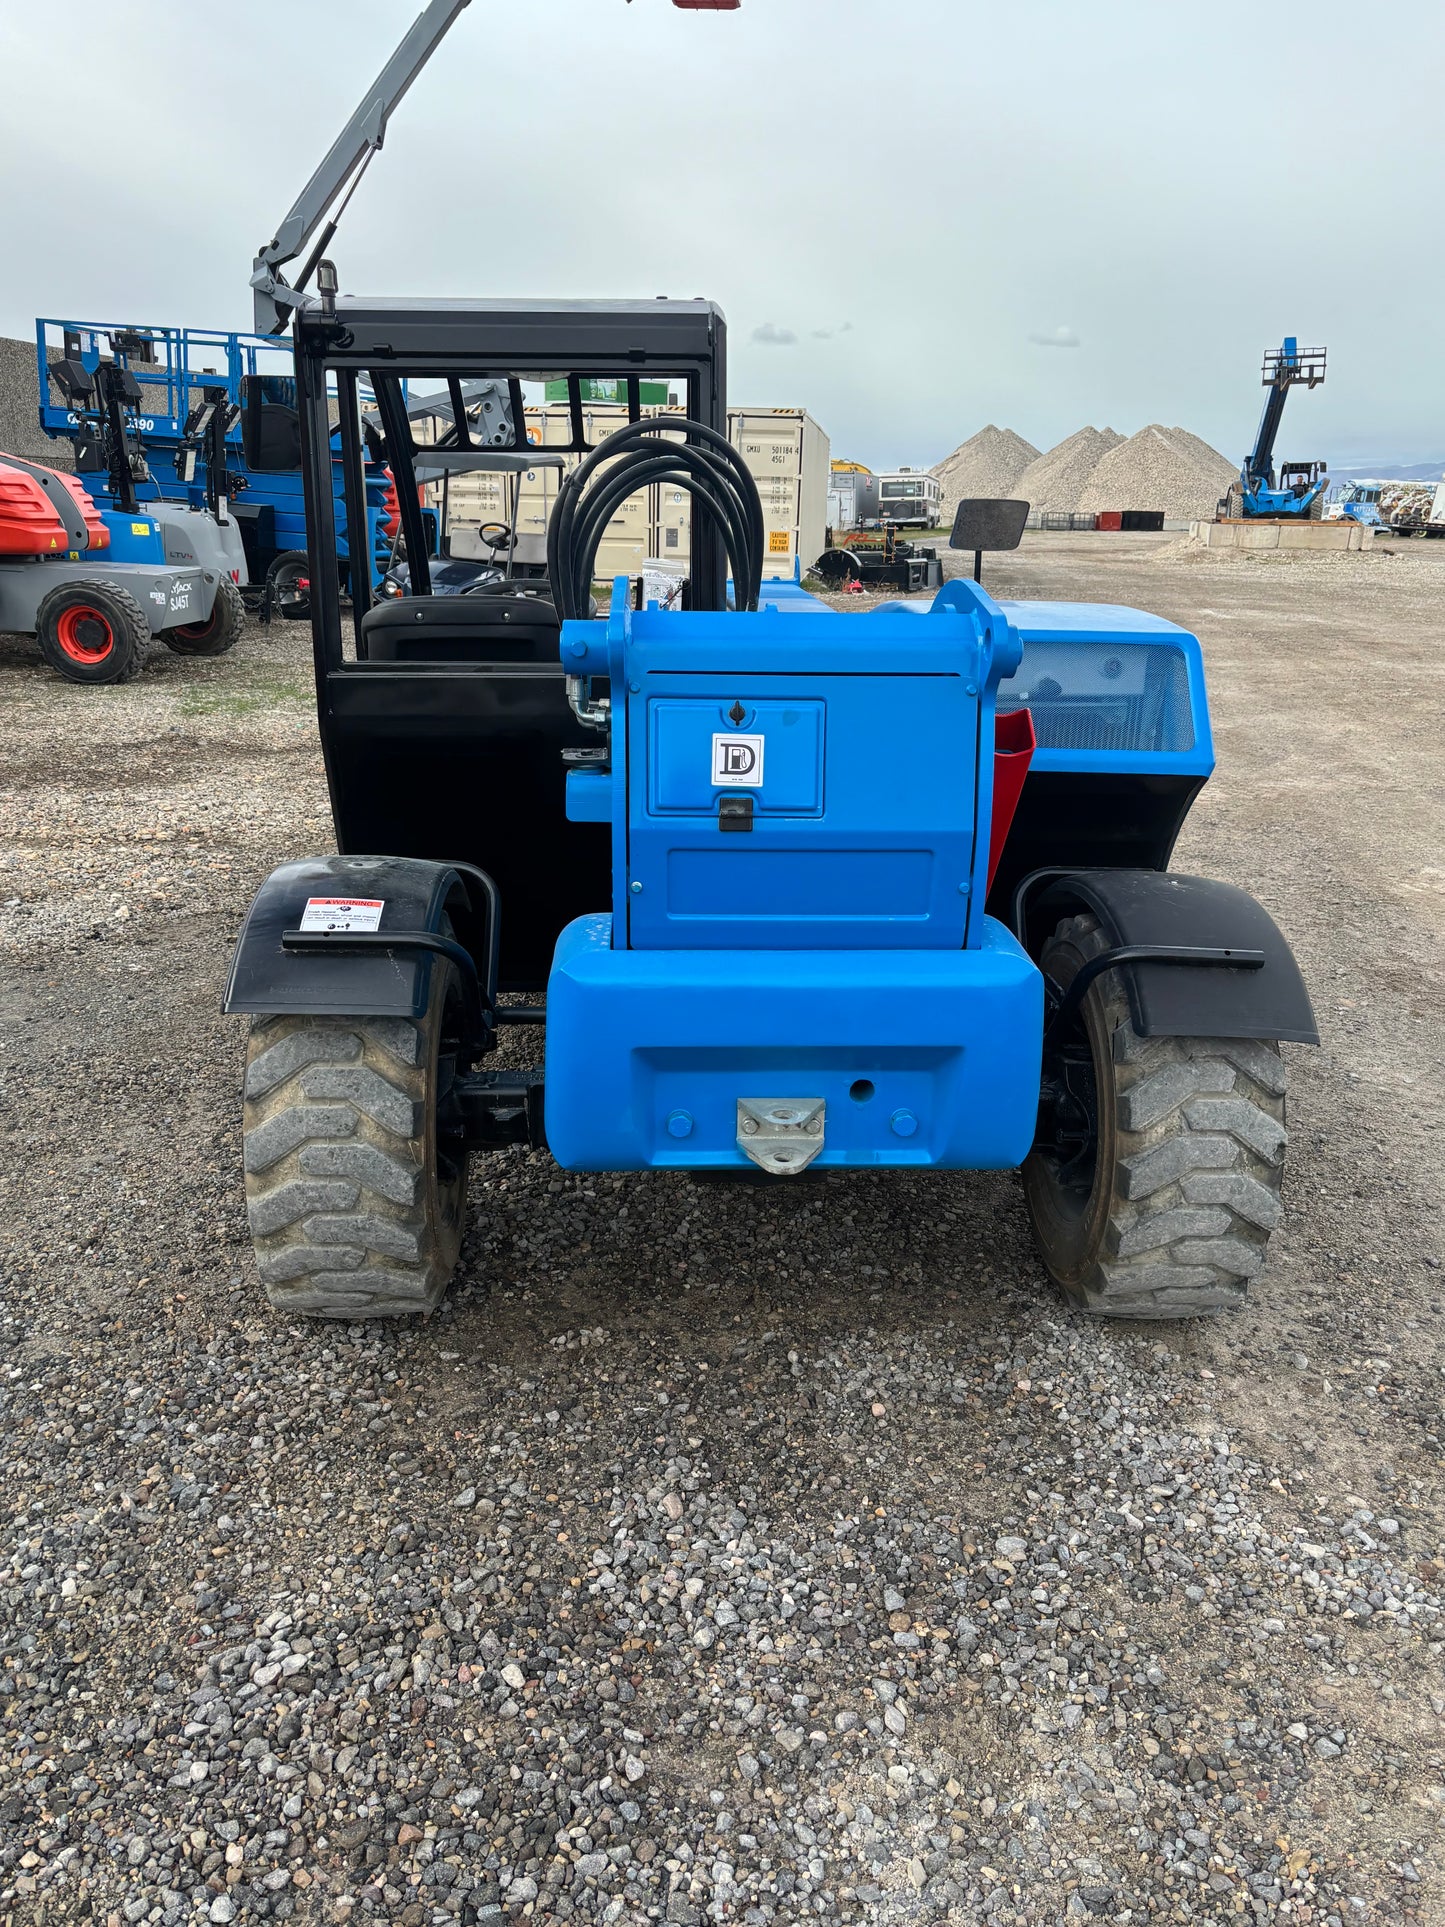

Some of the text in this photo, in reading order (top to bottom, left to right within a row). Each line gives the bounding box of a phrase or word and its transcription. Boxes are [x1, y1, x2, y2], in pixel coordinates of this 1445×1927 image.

[170, 594, 189, 612] SJ45T
[719, 743, 756, 775] D
[333, 899, 373, 907] WARNING
